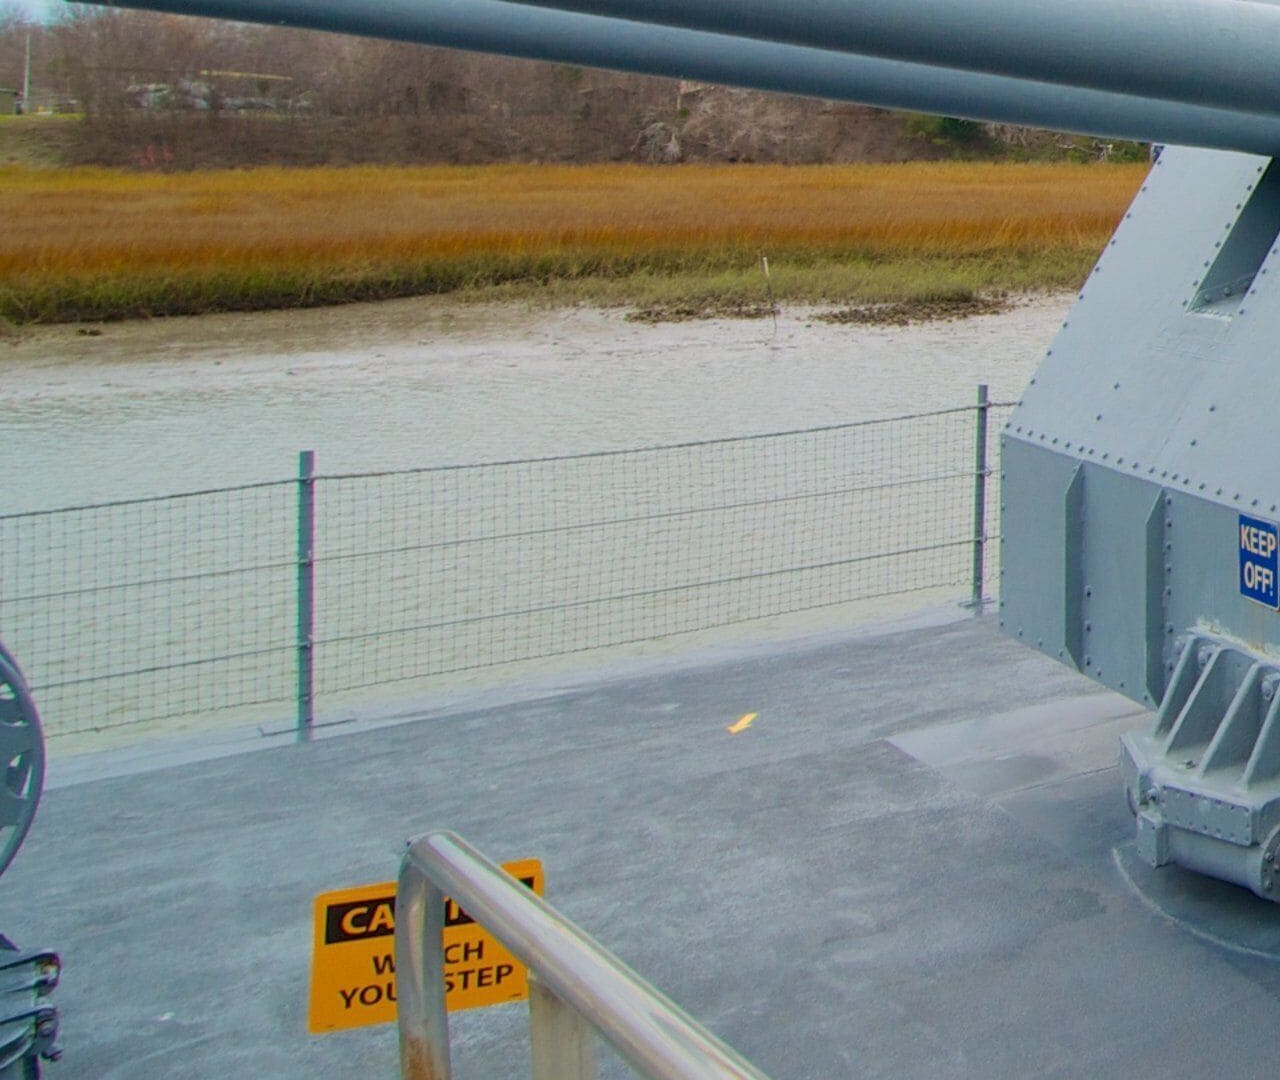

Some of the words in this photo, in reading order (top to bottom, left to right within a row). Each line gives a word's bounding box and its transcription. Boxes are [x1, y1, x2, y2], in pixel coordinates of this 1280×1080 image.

[1240, 524, 1276, 559] KEEP
[1243, 561, 1274, 597] OFF!
[373, 940, 484, 976] WCH
